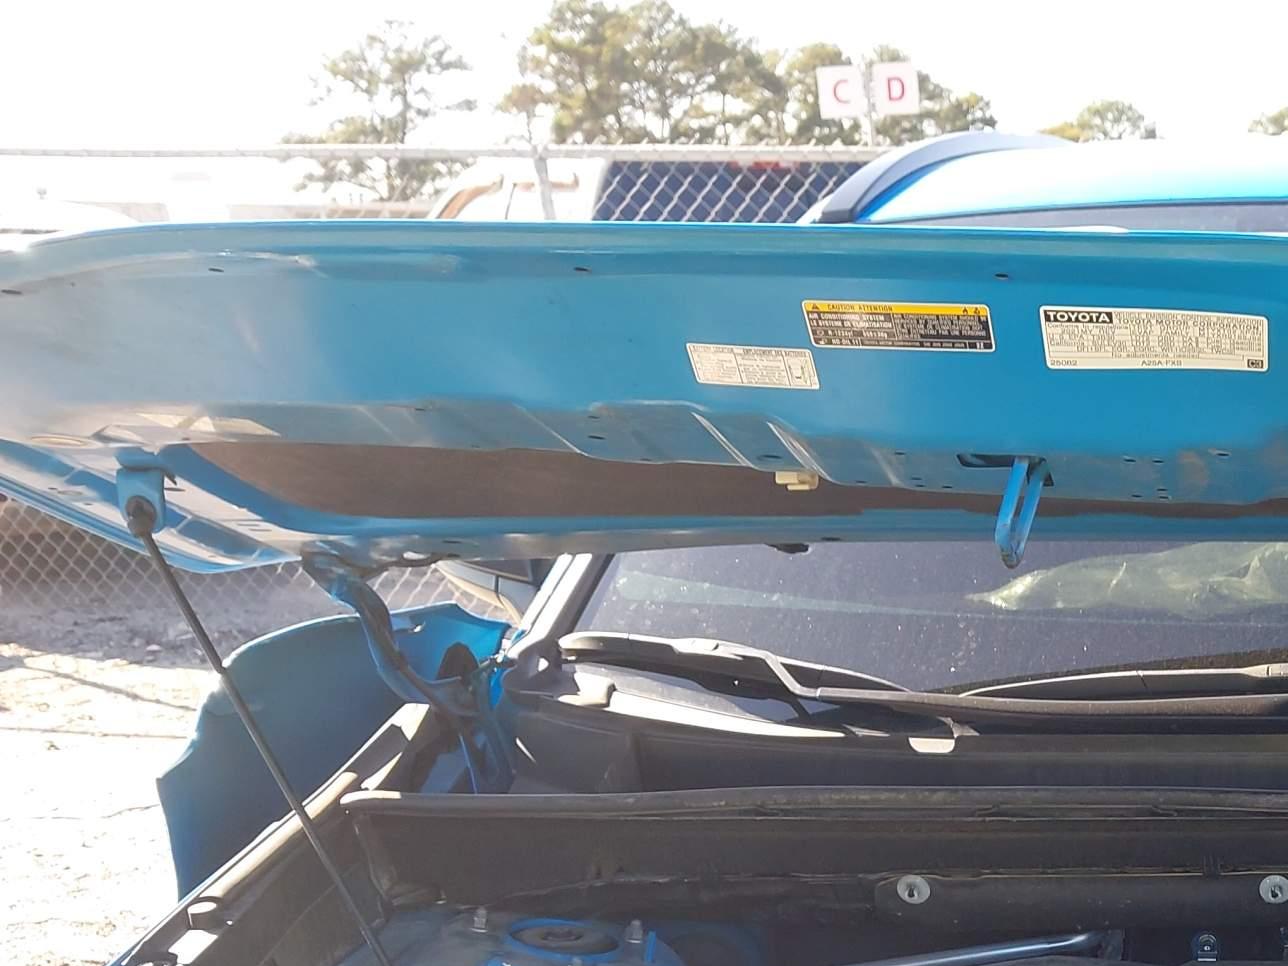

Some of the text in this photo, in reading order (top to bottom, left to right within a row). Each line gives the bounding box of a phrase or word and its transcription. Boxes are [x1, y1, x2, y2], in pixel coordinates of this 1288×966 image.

[832, 79, 851, 104] C
[886, 76, 906, 102] D
[858, 304, 893, 312] ATTENTION
[1046, 311, 1110, 323] TOYOTA
